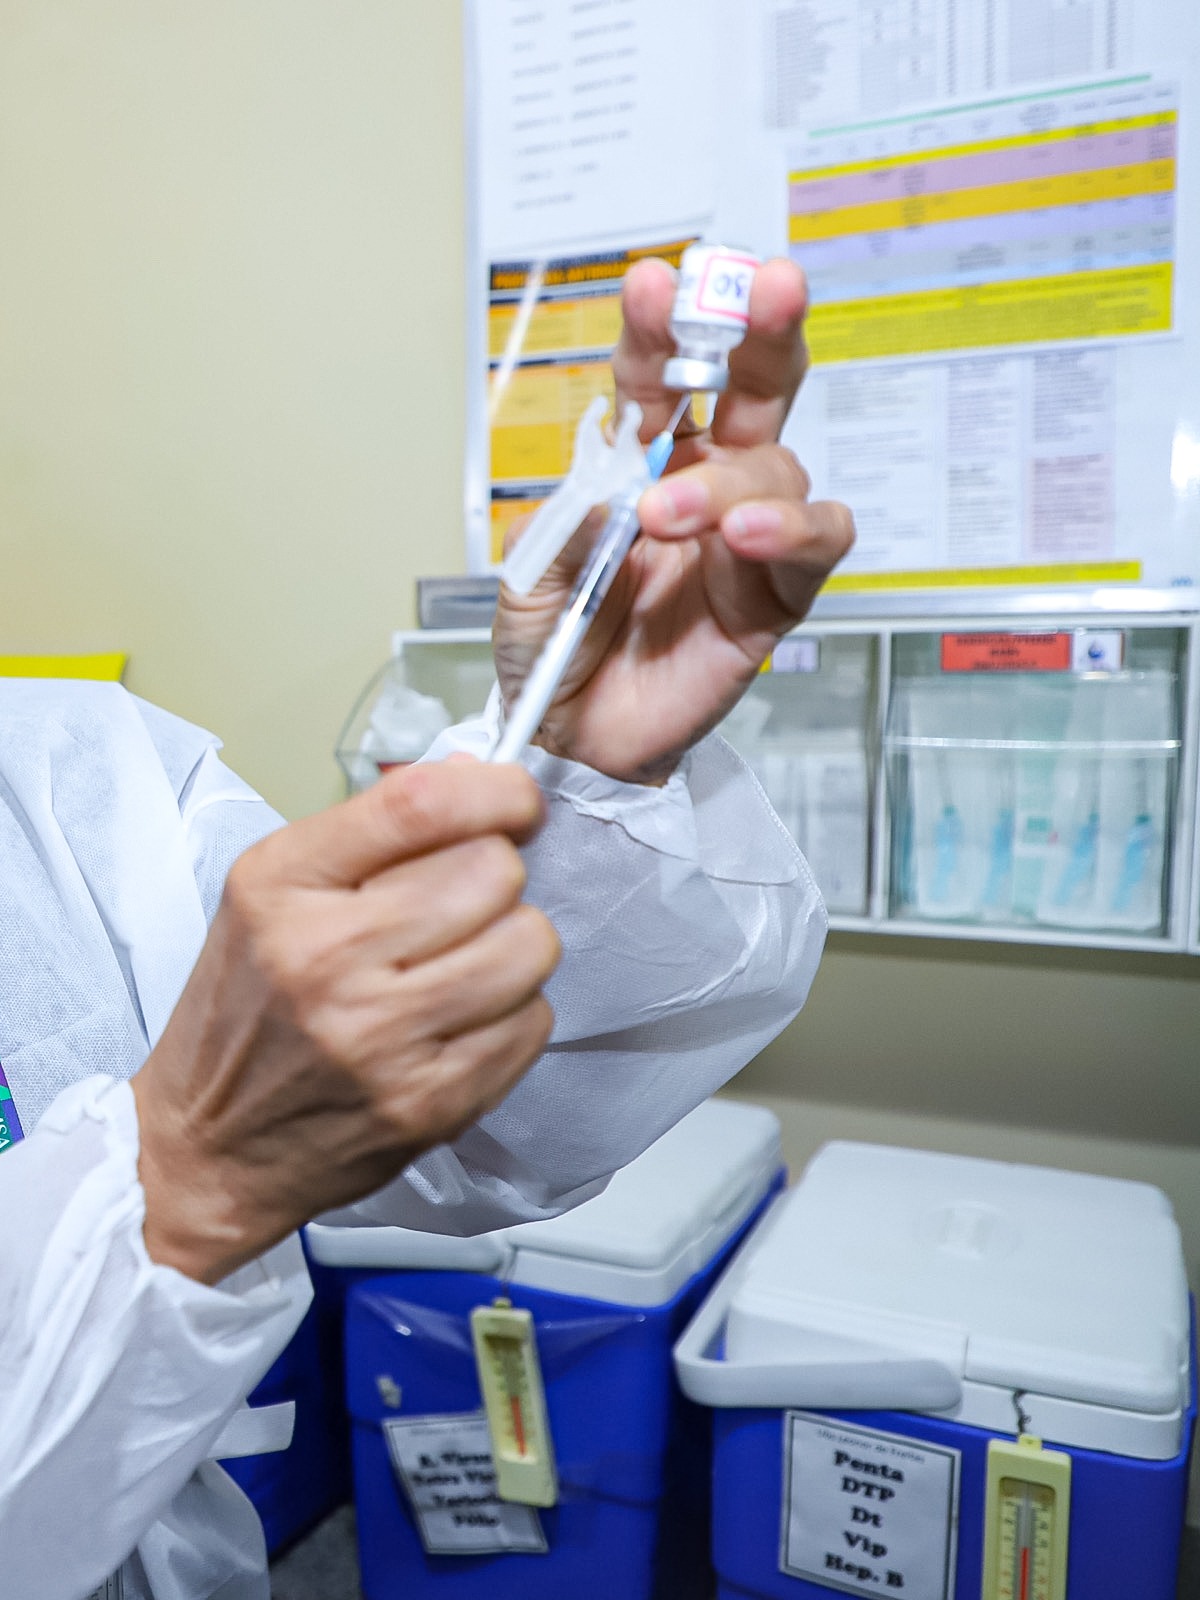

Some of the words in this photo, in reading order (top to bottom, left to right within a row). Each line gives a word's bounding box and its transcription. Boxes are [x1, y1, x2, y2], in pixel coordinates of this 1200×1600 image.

[834, 1450, 904, 1483] Penta
[841, 1476, 896, 1502] DTP
[851, 1506, 882, 1528] Dt
[843, 1530, 888, 1558] Vip
[825, 1553, 880, 1582] Hep.
